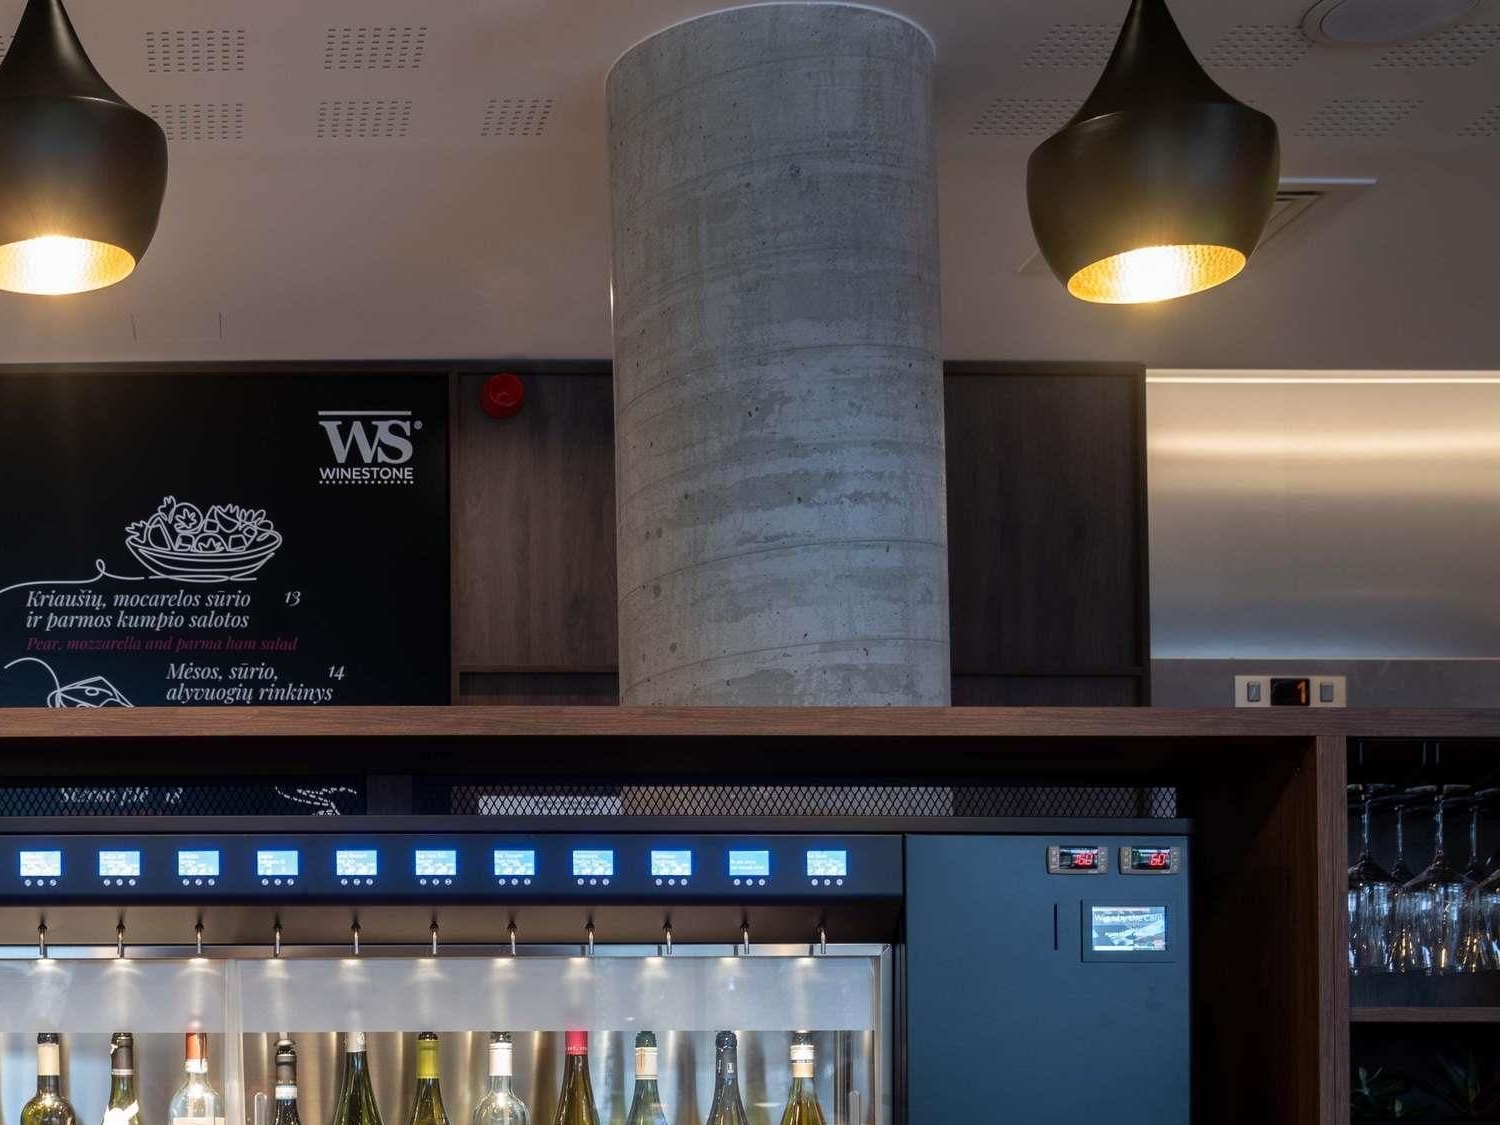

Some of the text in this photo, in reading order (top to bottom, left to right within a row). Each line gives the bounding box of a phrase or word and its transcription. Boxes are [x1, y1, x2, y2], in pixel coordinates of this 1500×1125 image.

[319, 467, 414, 480] WINESTONE
[25, 588, 251, 610] Kriaušių, mocarelos sūrio
[284, 590, 301, 607] 13
[25, 611, 250, 631] ir parmos kumpio salotos
[66, 637, 142, 651] mozzarella
[143, 637, 172, 650] and
[175, 637, 224, 654] parma
[225, 637, 258, 650] ham
[259, 637, 299, 651] salad
[165, 662, 279, 683] Mėsos, sūrio,
[327, 664, 346, 681] 14
[165, 683, 334, 704] alyvuogių rinkinys
[1297, 680, 1307, 704] 1
